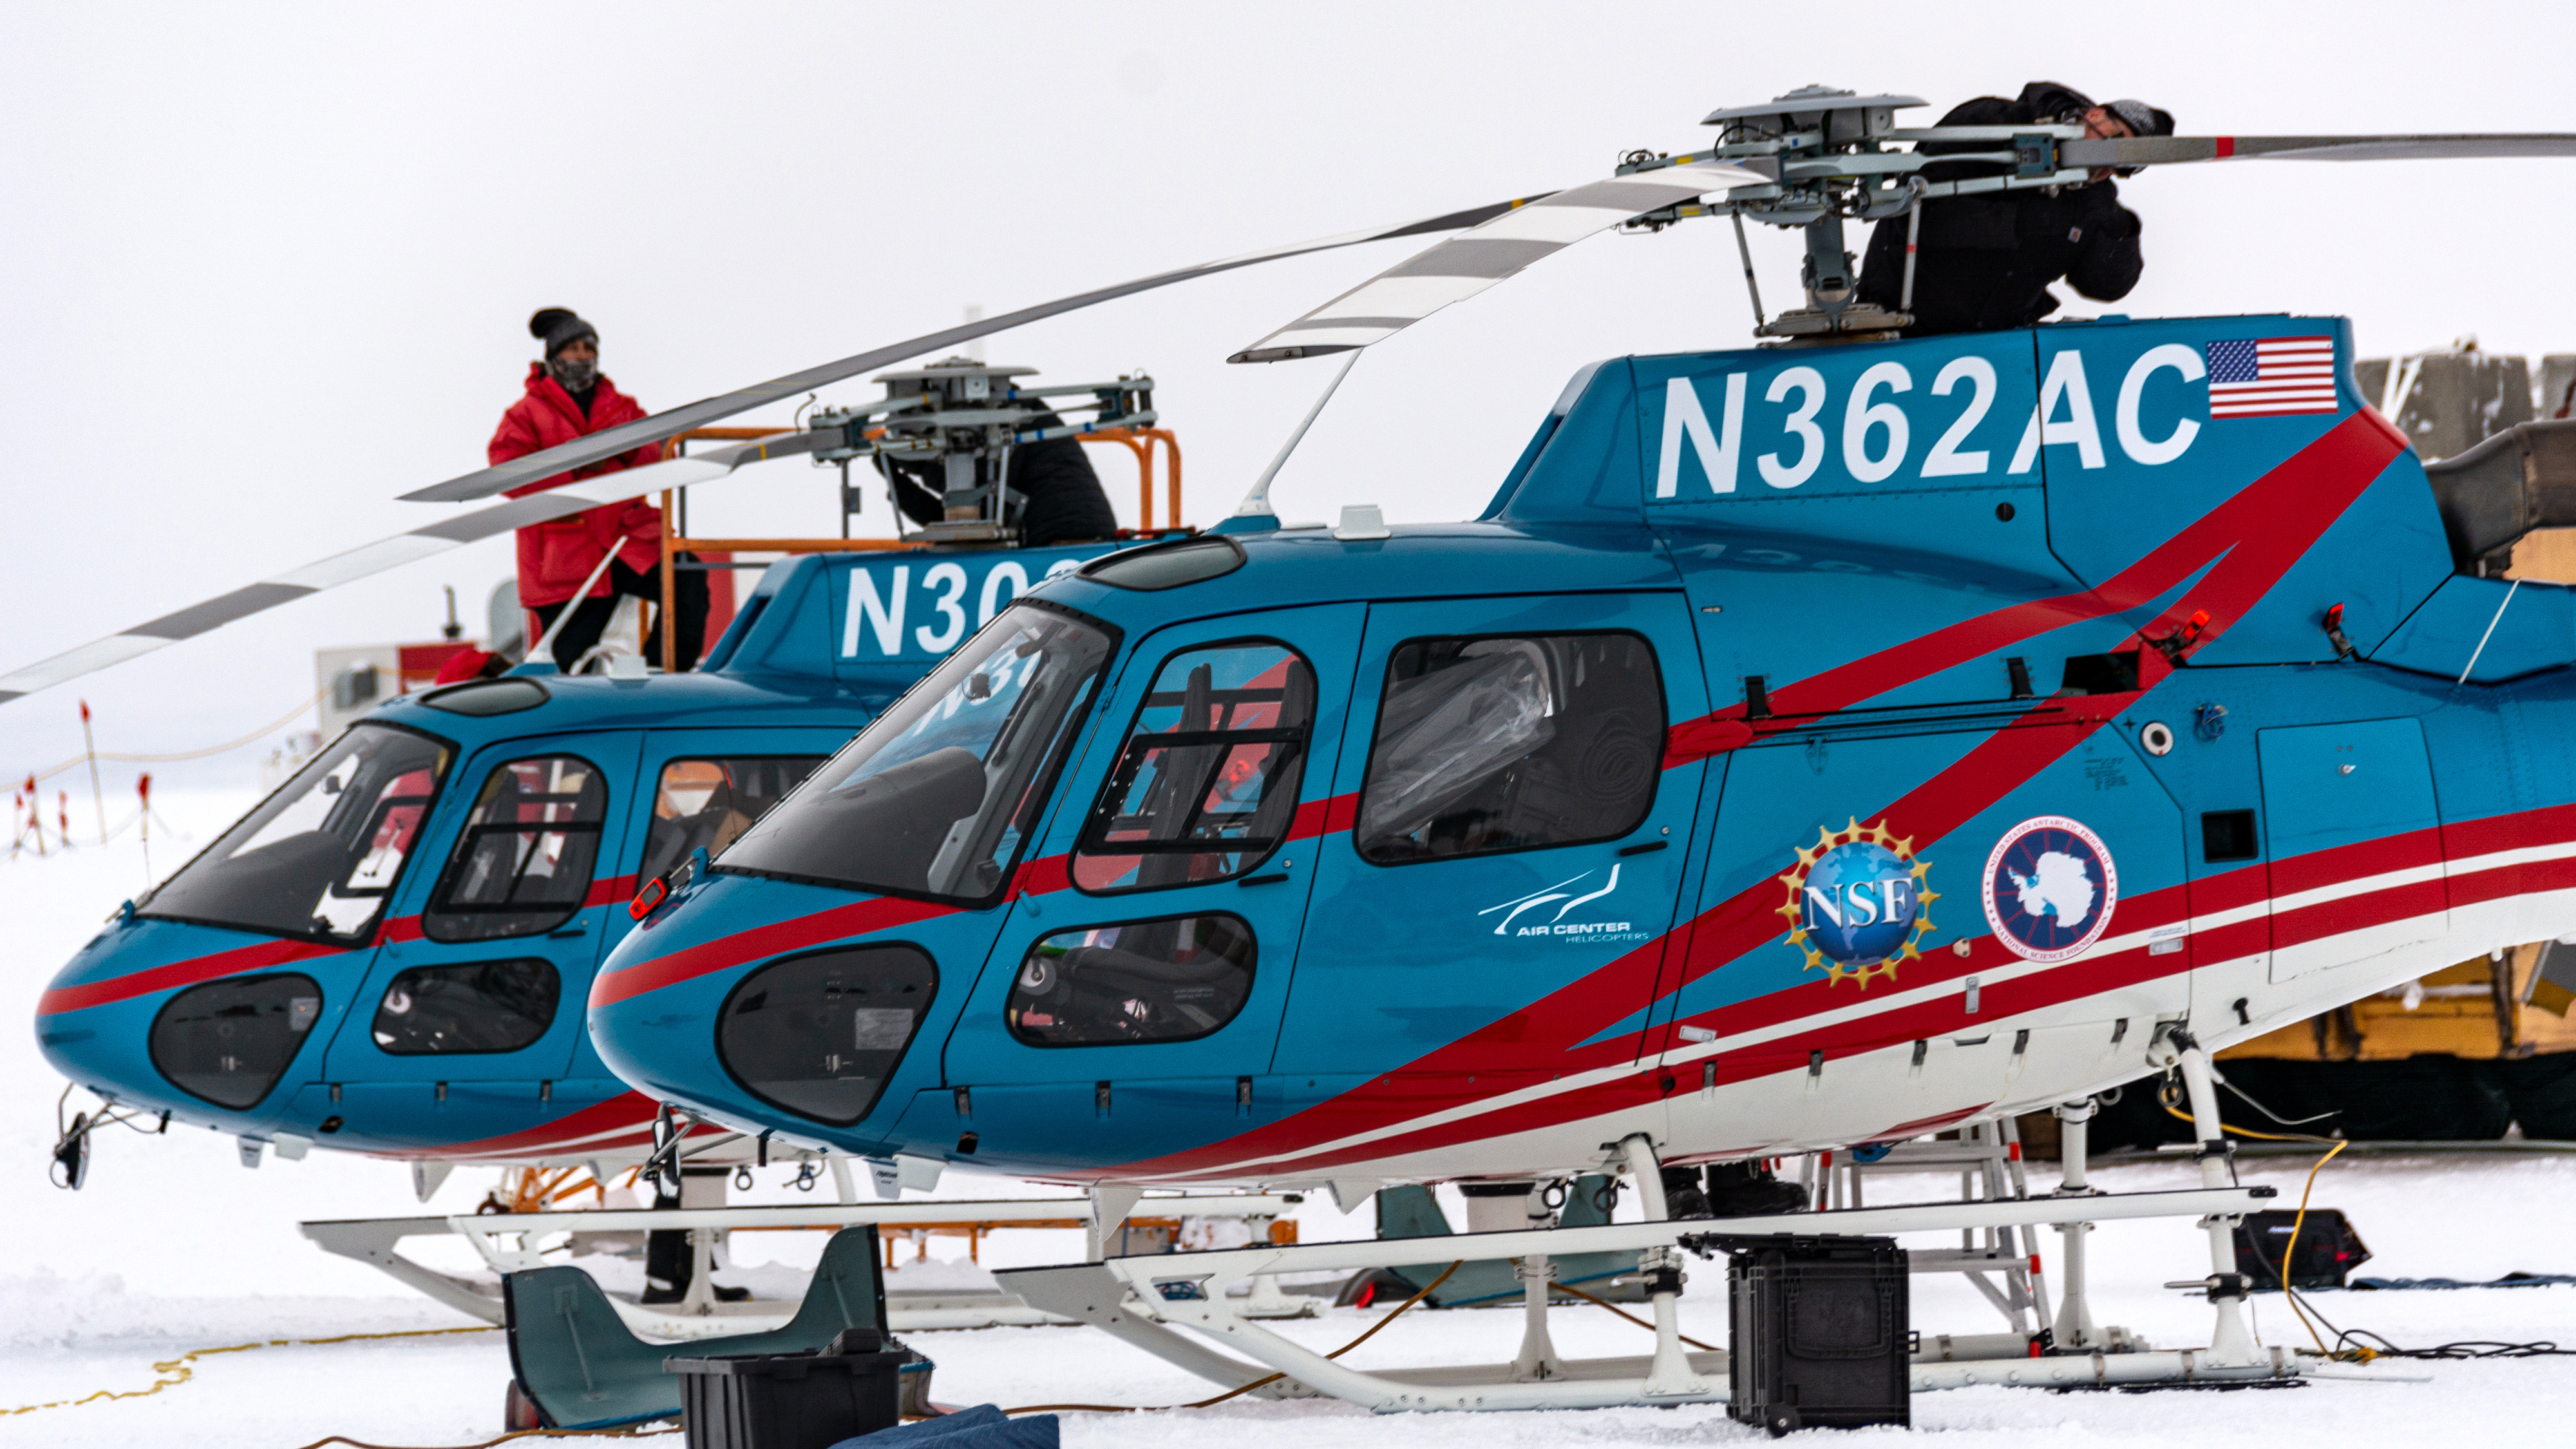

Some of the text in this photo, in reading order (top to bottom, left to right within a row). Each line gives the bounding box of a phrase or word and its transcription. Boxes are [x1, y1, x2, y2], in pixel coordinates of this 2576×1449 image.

[1656, 343, 2207, 498] N362AC
[841, 558, 1083, 658] N30
[1988, 819, 2110, 874] UNITED STATES ANTARCTIC PROGRAM
[1516, 922, 1631, 937] AIR CENTER
[1803, 876, 1916, 931] NSF
[1566, 932, 1650, 944] HELICOPTERS
[1996, 916, 2108, 960] NATIONAL SCIENCE FOUNDATION
